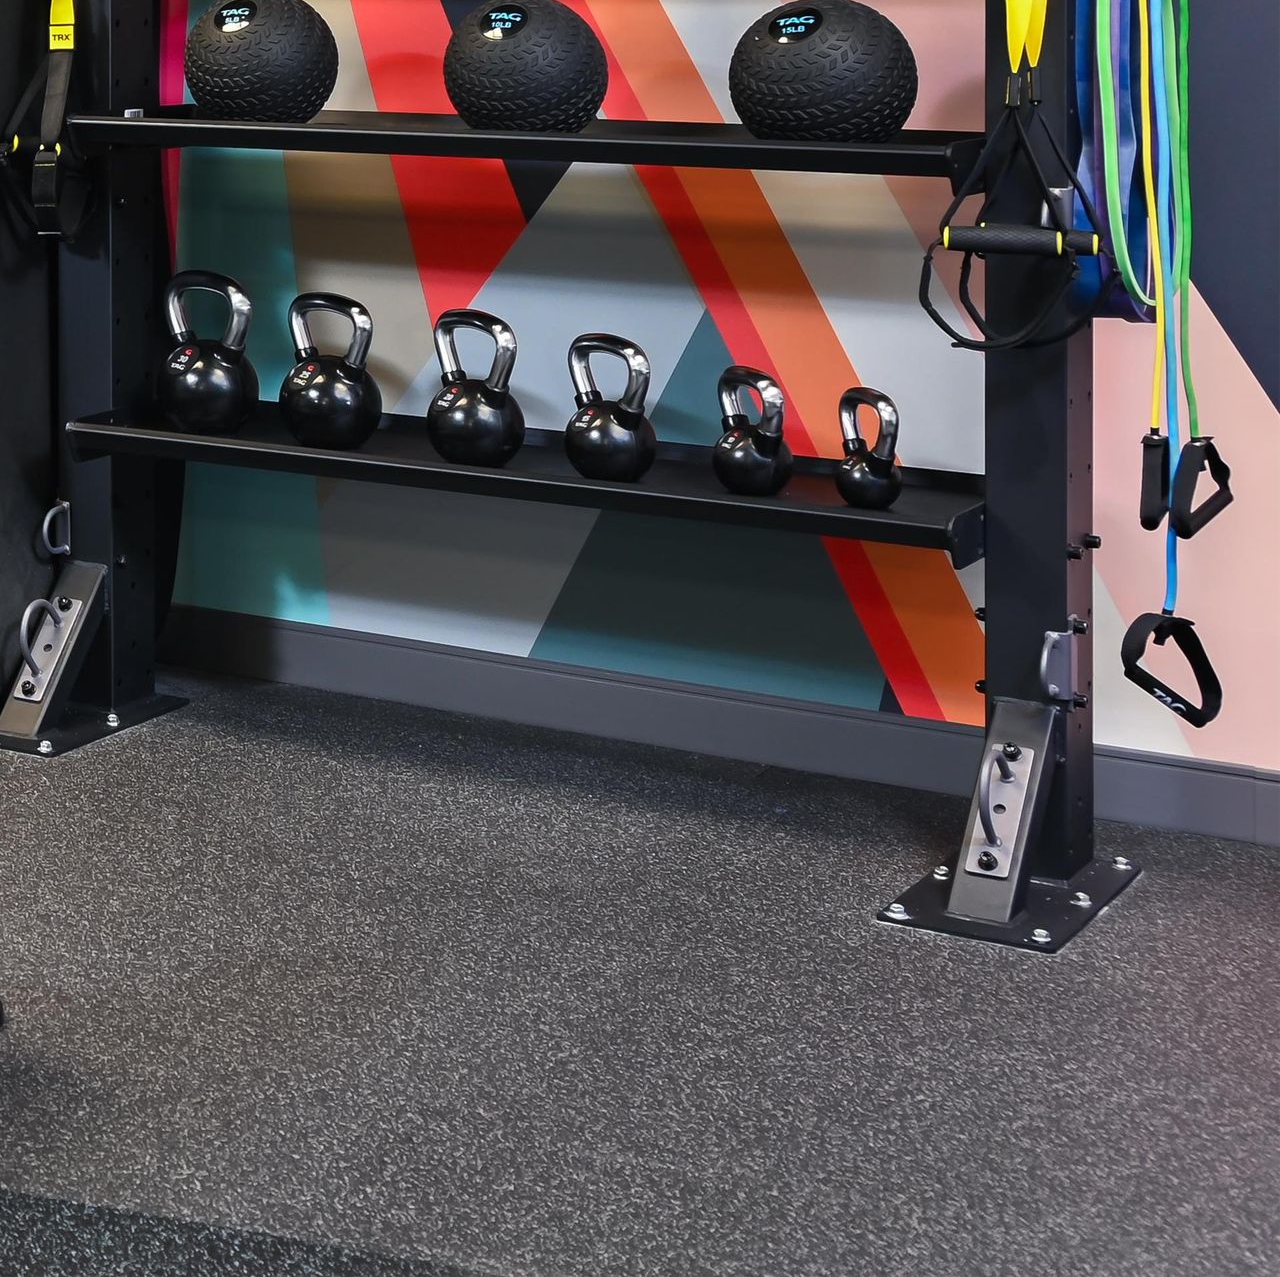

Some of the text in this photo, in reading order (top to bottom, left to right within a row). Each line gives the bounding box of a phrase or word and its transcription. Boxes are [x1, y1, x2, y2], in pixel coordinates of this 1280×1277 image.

[221, 8, 250, 17] TAG
[489, 13, 523, 22] TAG
[776, 16, 815, 26] TAG
[781, 25, 806, 34] 15LB
